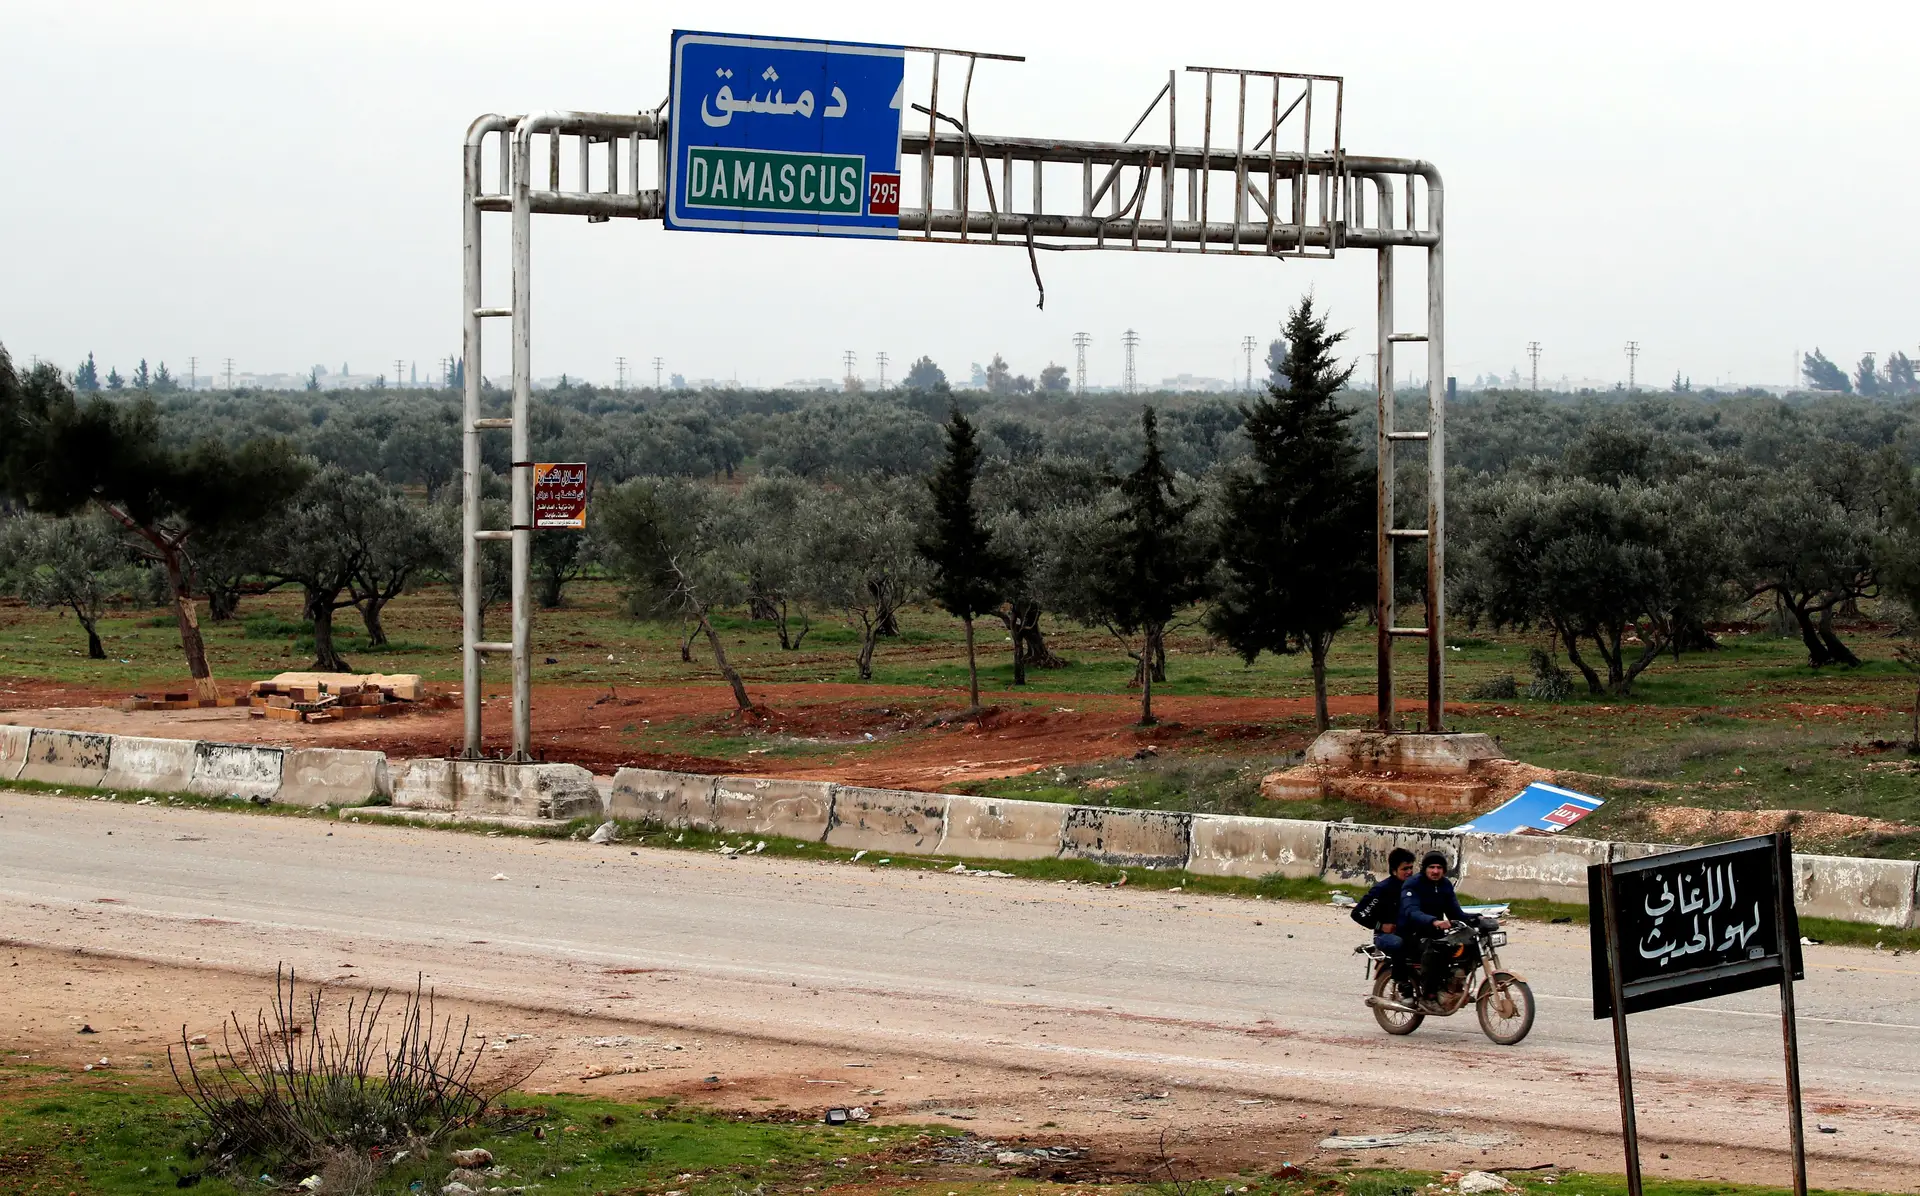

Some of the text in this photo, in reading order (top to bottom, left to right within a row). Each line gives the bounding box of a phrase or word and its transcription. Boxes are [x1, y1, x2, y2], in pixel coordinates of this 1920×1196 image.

[701, 65, 848, 128] دمشق
[691, 156, 857, 206] DAMASCUS
[871, 182, 898, 204] 295
[1554, 808, 1581, 822] km
[1644, 862, 1737, 925] الأغاني
[1638, 901, 1761, 967] لهو الحديث
